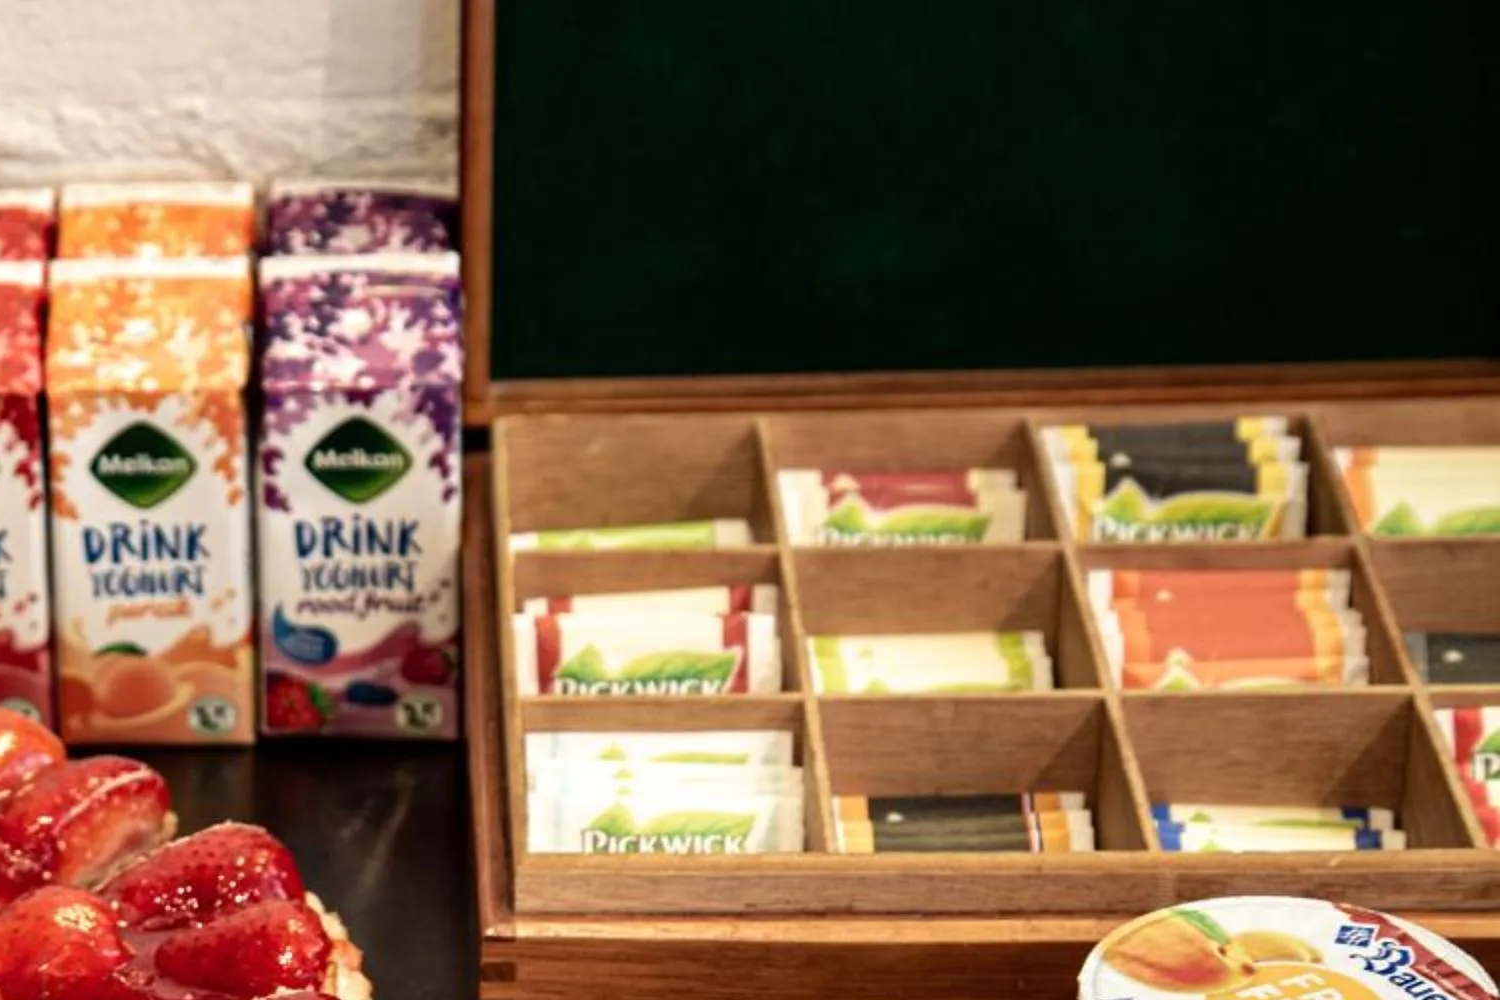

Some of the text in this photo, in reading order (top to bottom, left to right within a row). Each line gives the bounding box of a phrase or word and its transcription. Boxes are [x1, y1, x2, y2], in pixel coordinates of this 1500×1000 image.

[100, 454, 190, 475] Melkan
[313, 449, 405, 470] Melkan
[91, 566, 207, 598] YOGHURT
[302, 561, 417, 593] YOGHURT
[580, 827, 747, 855] PICKWICK
